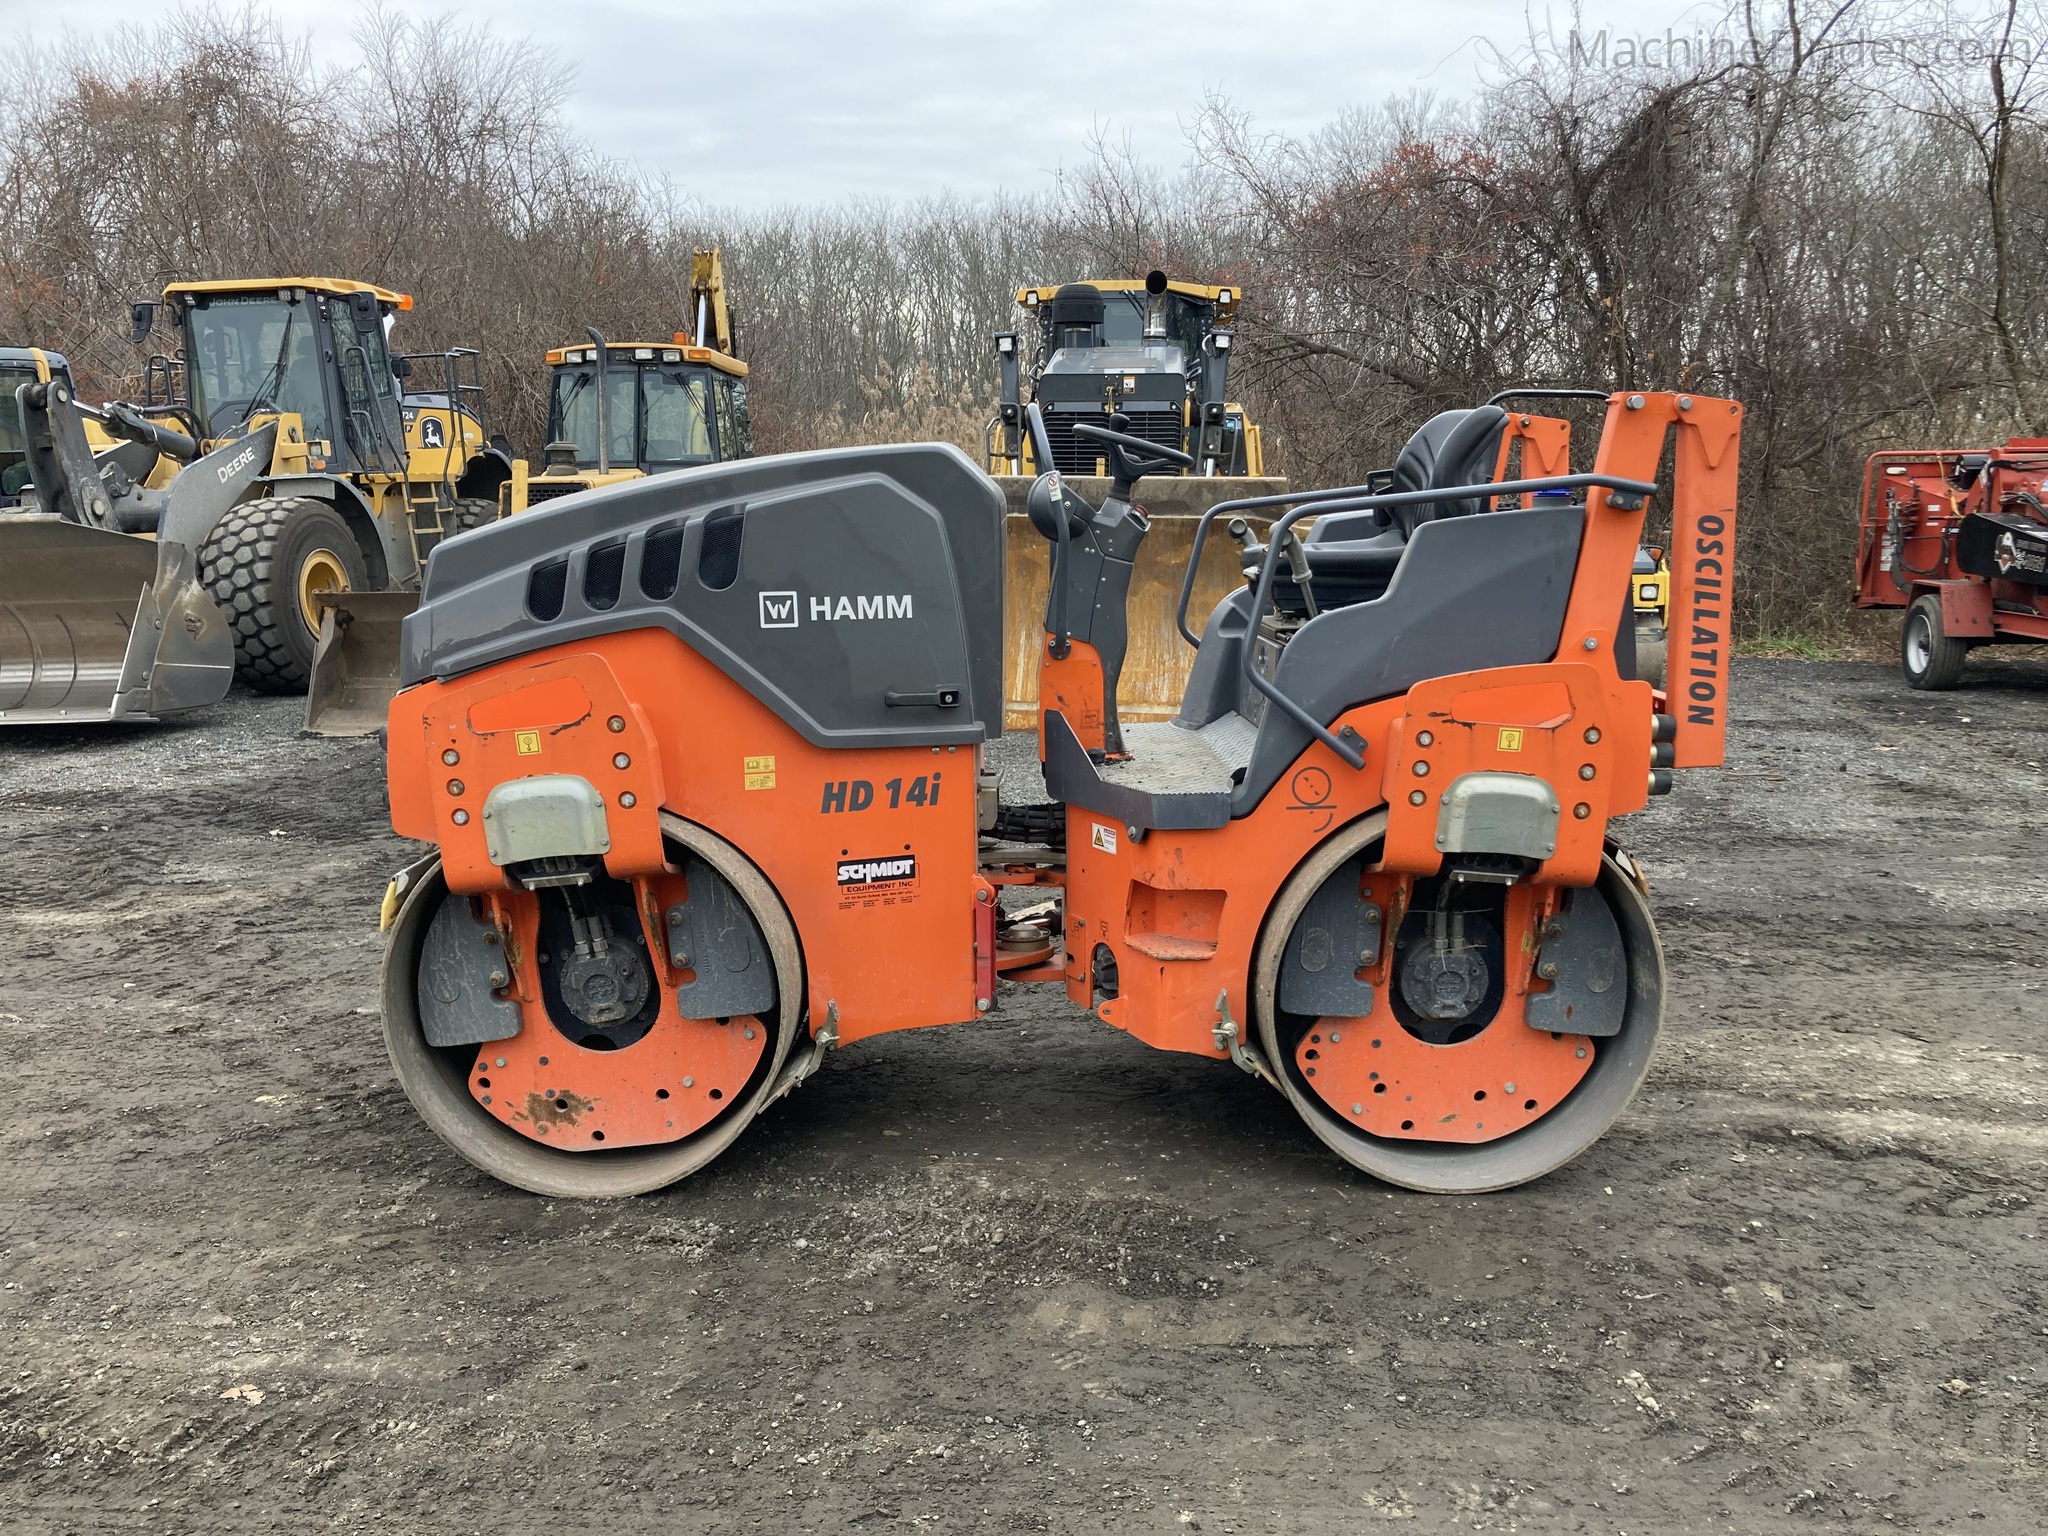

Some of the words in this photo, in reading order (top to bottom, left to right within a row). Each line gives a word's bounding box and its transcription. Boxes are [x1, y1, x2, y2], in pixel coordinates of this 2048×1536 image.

[209, 298, 238, 307] JOHN
[241, 296, 277, 305] DEERE
[217, 446, 255, 484] DEERE
[810, 594, 913, 621] HAMM
[1687, 515, 1725, 726] OSCILLATION
[821, 780, 874, 814] HD
[885, 772, 942, 809] 14i
[837, 859, 914, 884] SCHMIDT
[847, 882, 896, 893] EQUIPMENT
